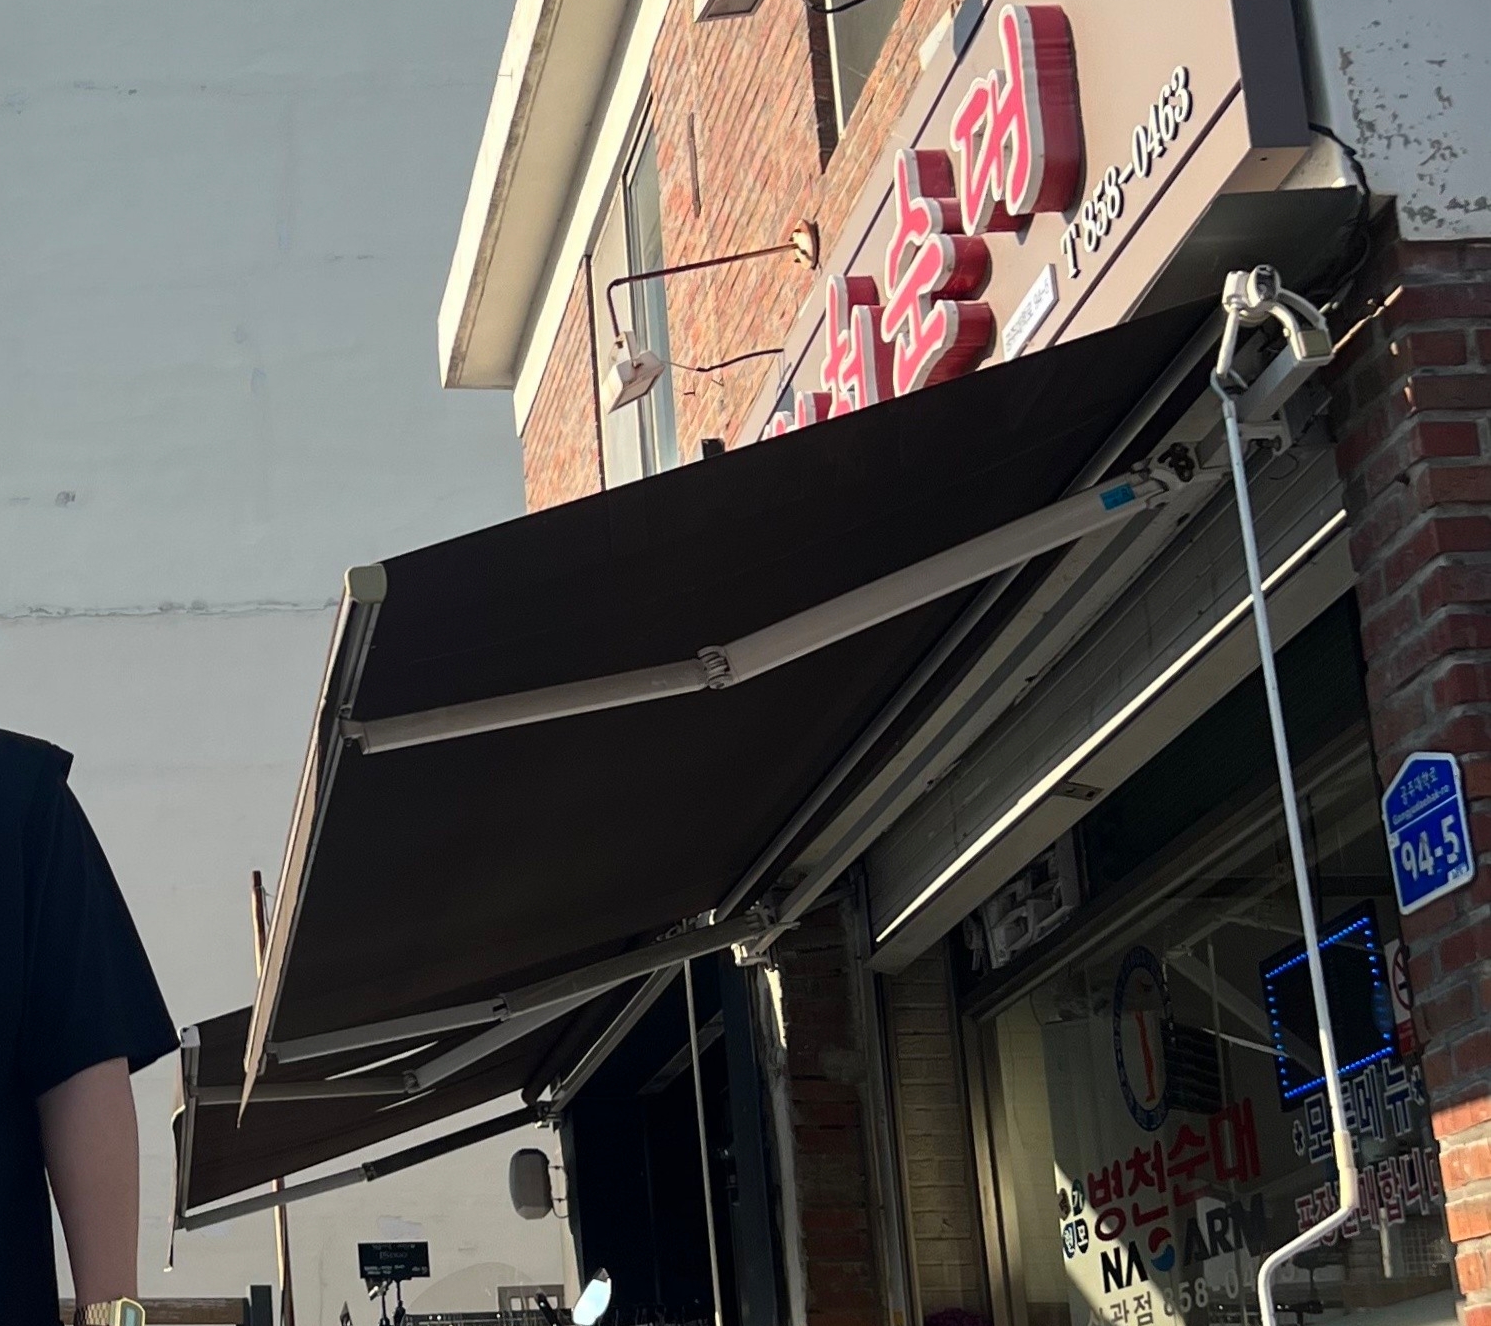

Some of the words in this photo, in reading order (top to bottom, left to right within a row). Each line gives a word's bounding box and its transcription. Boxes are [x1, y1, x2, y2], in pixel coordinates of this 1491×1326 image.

[1081, 65, 1195, 253] 858-0463
[1401, 815, 1460, 882] 94-5
[1087, 1097, 1261, 1243] 병천순대
